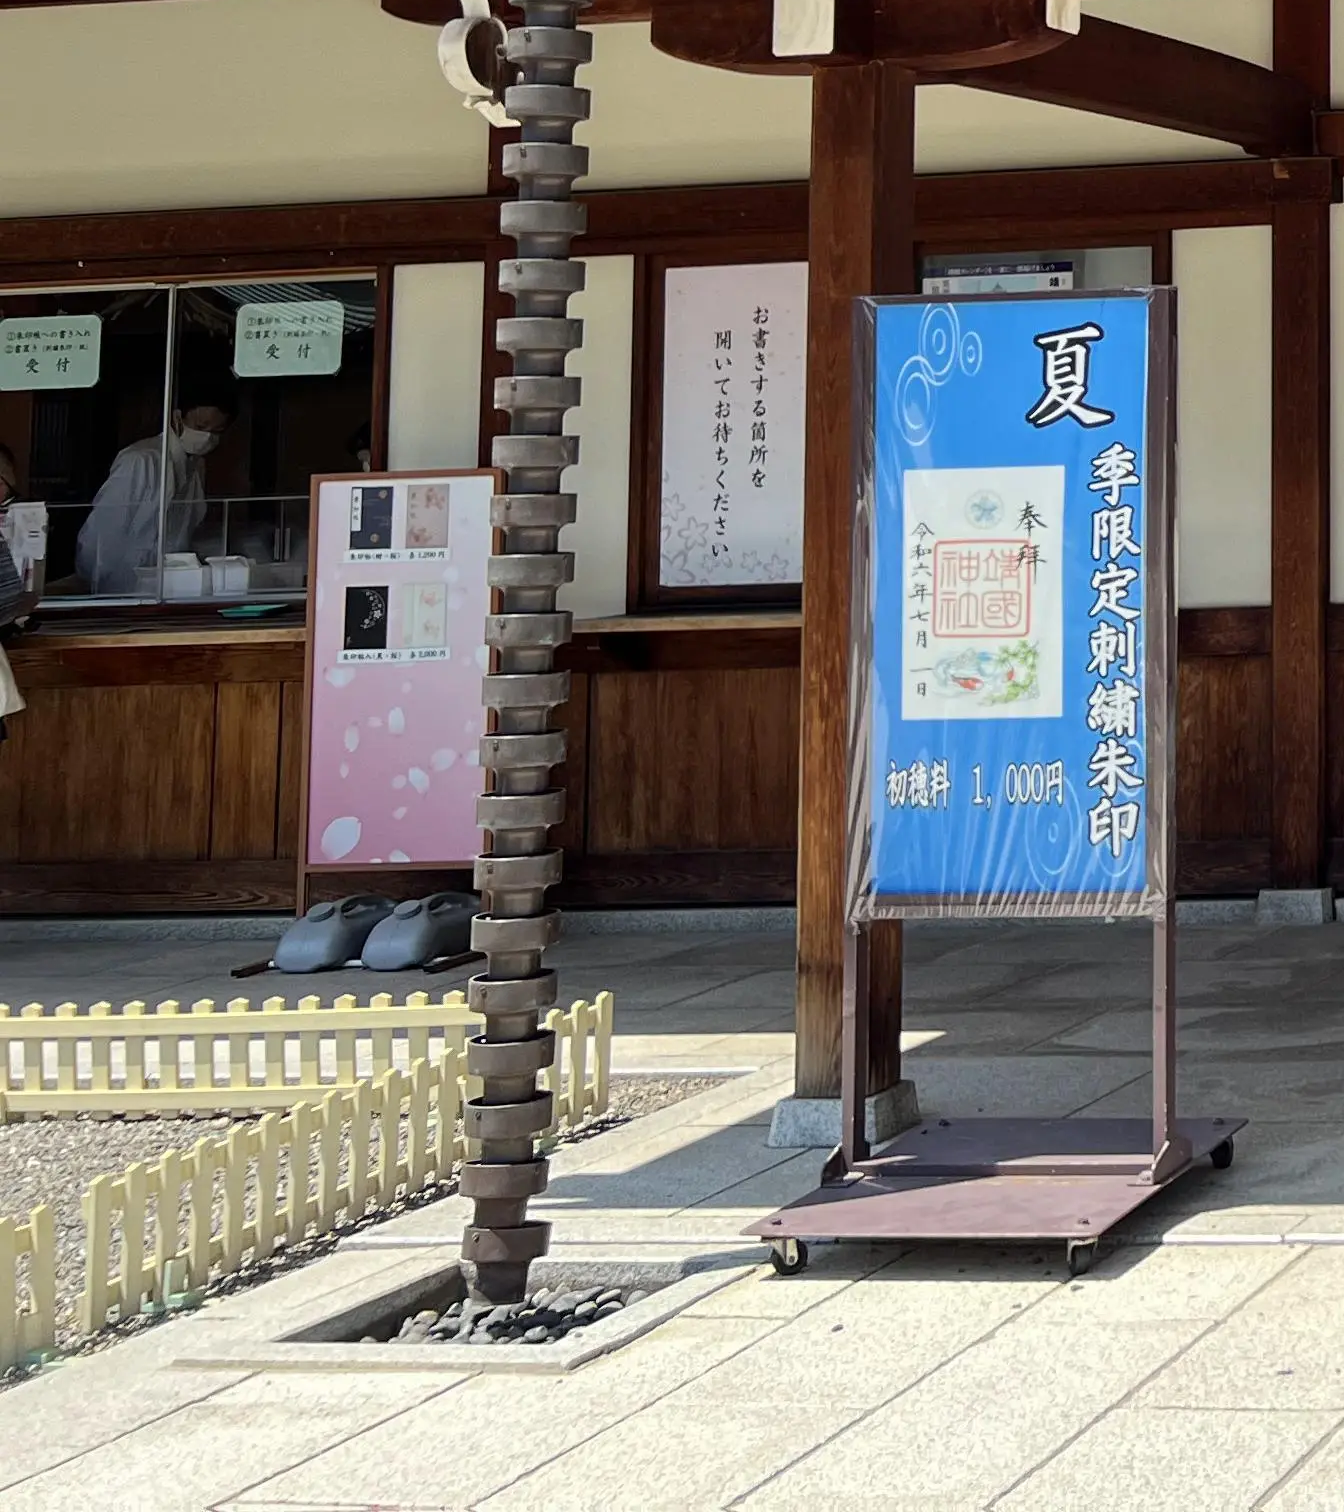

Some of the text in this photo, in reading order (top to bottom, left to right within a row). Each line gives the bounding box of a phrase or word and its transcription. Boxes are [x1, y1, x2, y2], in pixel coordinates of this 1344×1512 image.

[26, 357, 71, 374] 受付
[265, 343, 311, 360] 受付
[749, 305, 770, 489] お書きする箇所を
[711, 329, 733, 558] 開いてお待ちください
[885, 758, 951, 809] 初穂料
